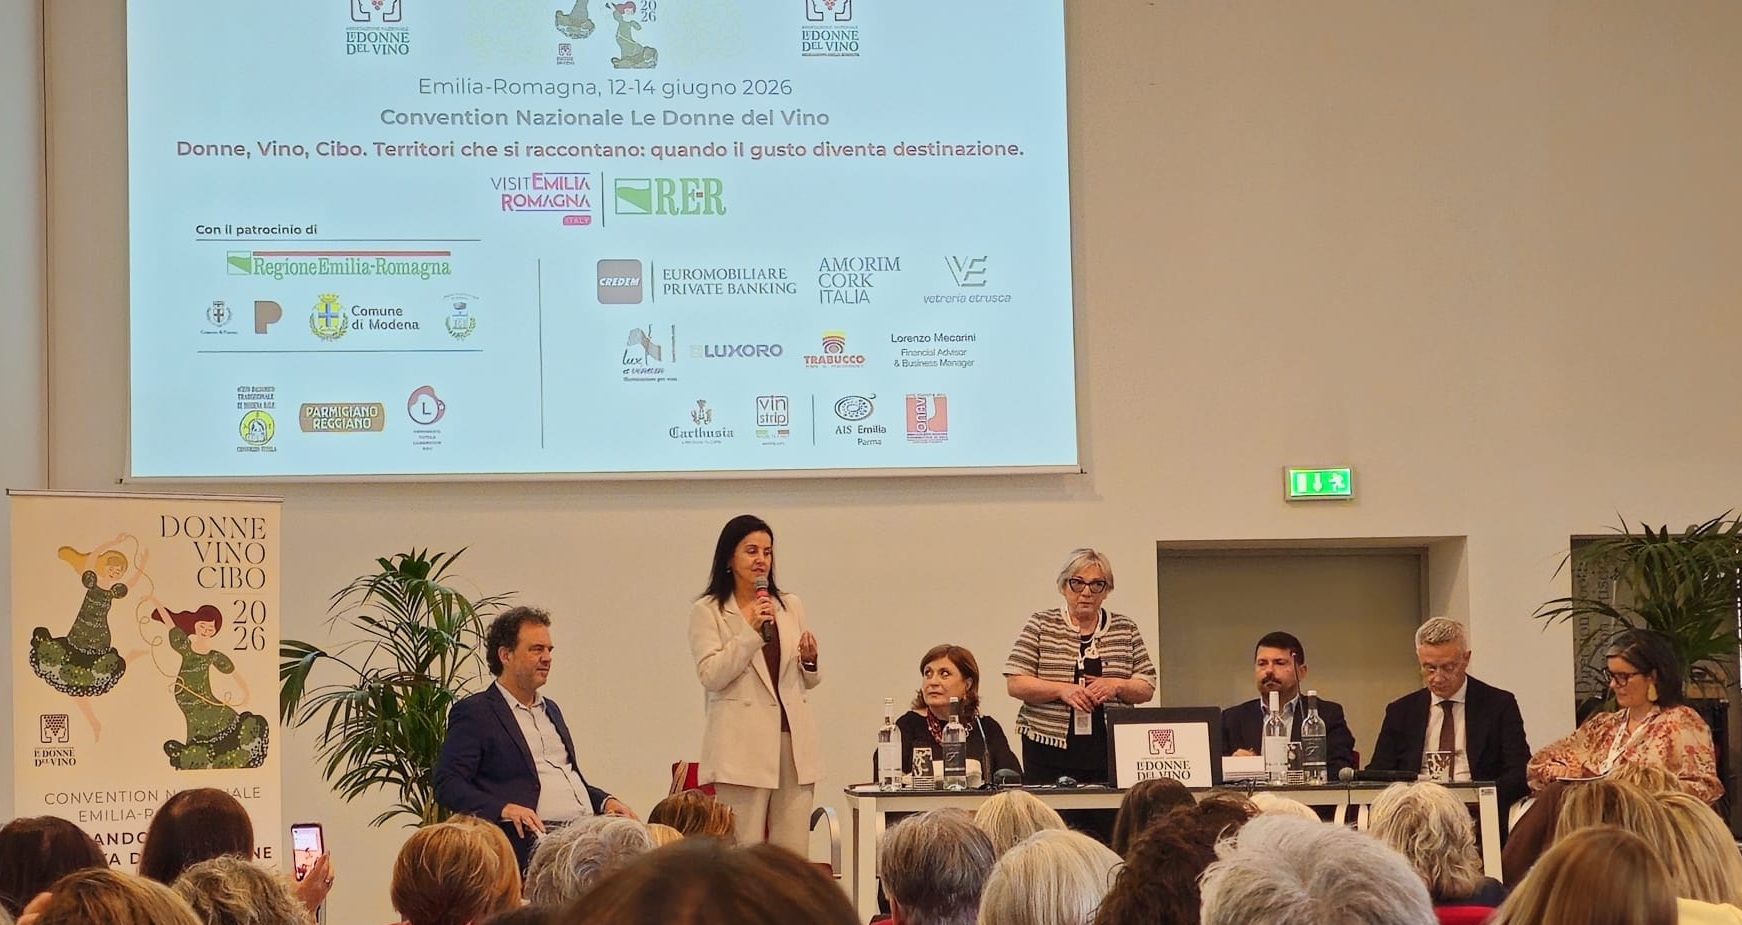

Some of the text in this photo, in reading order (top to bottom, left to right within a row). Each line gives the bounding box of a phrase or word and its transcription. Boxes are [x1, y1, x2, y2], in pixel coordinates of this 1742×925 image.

[640, 11, 657, 22] 26
[357, 31, 410, 43] DONNE
[811, 30, 860, 41] DONNE
[372, 43, 410, 55] VINO
[825, 41, 859, 52] VINO
[419, 78, 793, 100] Emilia-Romagna, 12-14 giugno 2026
[380, 108, 830, 127] Convention Nazionale Le Donne del Vino
[176, 139, 1025, 161] Donne, Vino, Cibo. Territori che si raccontano: quando il gusto diventa destinazione.
[501, 193, 591, 212] ROMAGNA
[654, 177, 727, 216] RER
[195, 224, 318, 239] Con il patrocinio di
[818, 256, 902, 272] AMORIM
[662, 267, 788, 281] EUROMOBILIARE
[818, 272, 875, 289] CORK
[599, 277, 640, 287] CREDEM
[662, 282, 797, 296] PRIVATE BANKING
[820, 289, 871, 305] ITALIA
[923, 293, 1012, 304] vetreria etrusca
[351, 305, 403, 317] Comune
[351, 318, 421, 331] di Modena
[891, 333, 932, 343] Lorenzo
[704, 343, 784, 359] LUXORO
[803, 354, 866, 366] TRABUCCO
[306, 405, 379, 418] PARMIGIANO
[312, 417, 372, 430] REGGIANO
[835, 424, 888, 435] AIS Emilia
[160, 514, 267, 541] DONNE
[192, 541, 267, 565] VINO
[196, 565, 267, 591] CIBO
[232, 599, 267, 625] 20
[232, 626, 266, 652] 26
[50, 758, 77, 768] VINO
[1145, 760, 1191, 771] DONNE
[44, 790, 159, 806] CONVENTION
